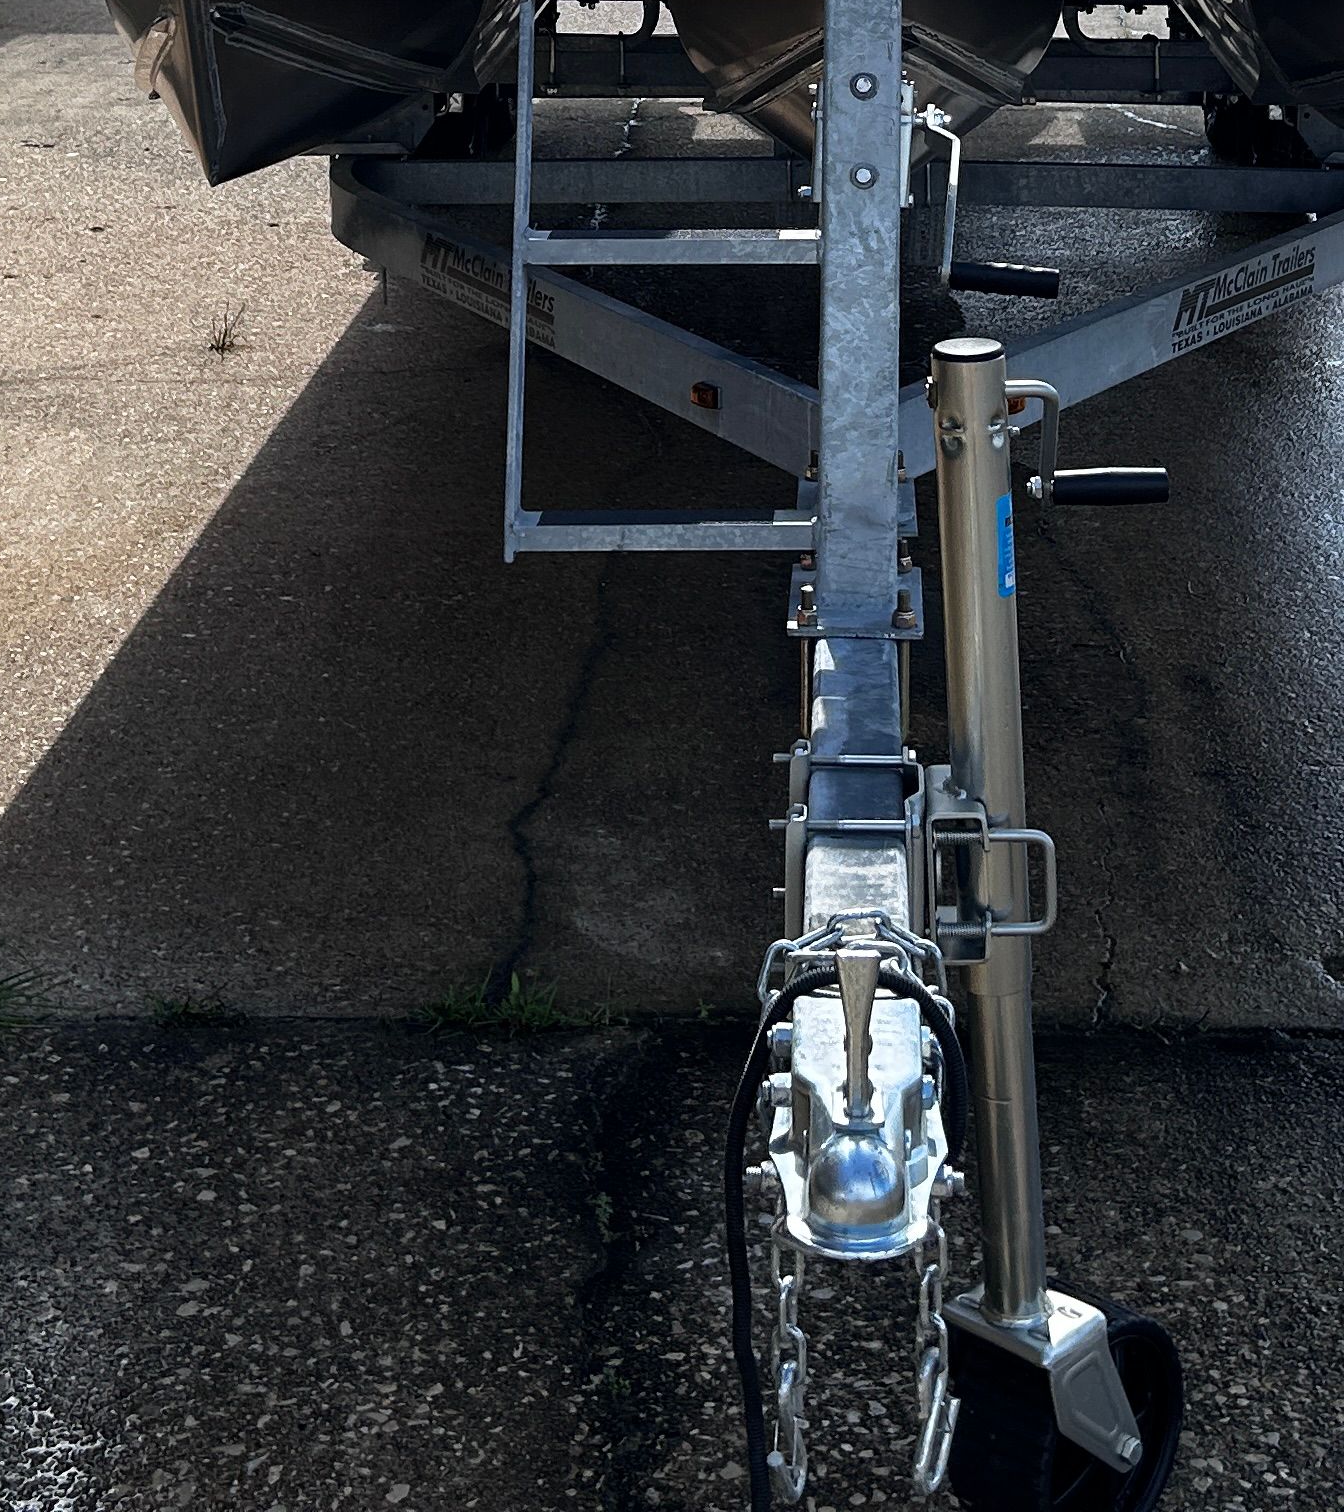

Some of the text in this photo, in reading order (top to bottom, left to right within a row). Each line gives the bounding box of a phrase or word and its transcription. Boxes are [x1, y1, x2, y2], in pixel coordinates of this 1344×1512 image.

[453, 245, 504, 289] McClain
[1212, 260, 1268, 303] McClain
[1270, 245, 1316, 279] Trailers
[1171, 284, 1314, 354] TEXAS LOUISIANA ALABAMA
[1247, 290, 1280, 309] LONG
